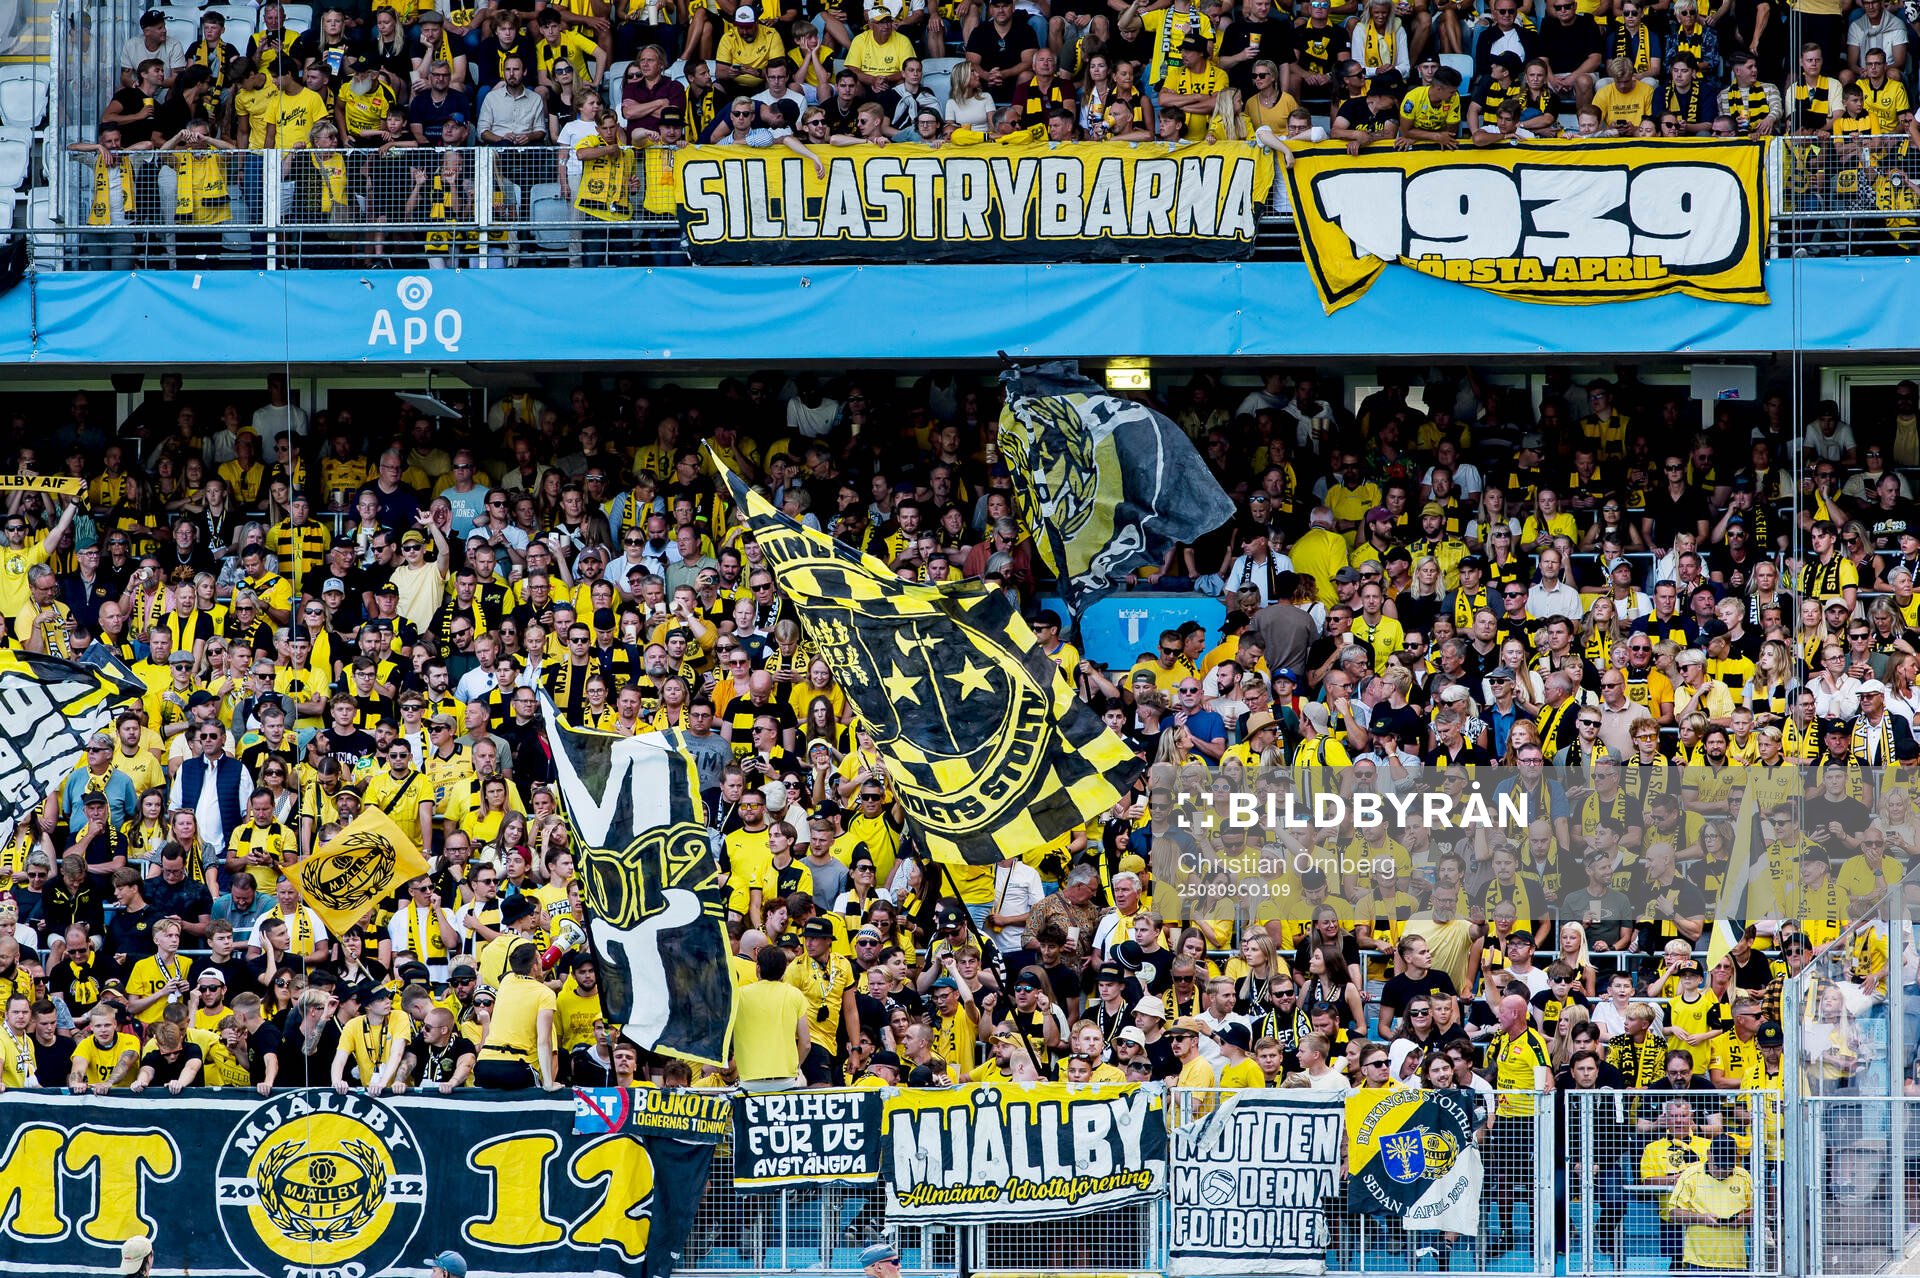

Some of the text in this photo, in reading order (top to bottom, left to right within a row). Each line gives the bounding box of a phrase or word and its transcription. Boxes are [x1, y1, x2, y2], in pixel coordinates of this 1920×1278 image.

[683, 157, 1255, 241] SILLASTRYBARNA
[1316, 165, 1741, 269] 1939
[1408, 254, 1669, 283] ÖRSTA APRIL
[368, 308, 463, 354] ApQ
[41, 476, 68, 489] AIF
[219, 1066, 250, 1083] MELLB
[633, 1088, 731, 1121] BOJKOTTA
[633, 1111, 690, 1131] LÖGNERNAS
[746, 1091, 864, 1123] FRIHET
[1356, 1088, 1421, 1146] BLEKINGES
[235, 1089, 412, 1158] MJÄLLBY
[749, 1122, 866, 1155] FÖR DE
[892, 1087, 1148, 1193] MJÄLLBY
[1262, 1112, 1341, 1164] DEN
[753, 1153, 868, 1178] AVSTÄNGDA
[220, 1181, 423, 1199] 20 12
[284, 1182, 360, 1203] MJÄLLBY
[898, 1168, 1153, 1207] Allmänna Idrottsförening
[1363, 1173, 1404, 1214] SEDAN
[1413, 1201, 1450, 1219] APRIL
[1448, 1175, 1469, 1205] 1939
